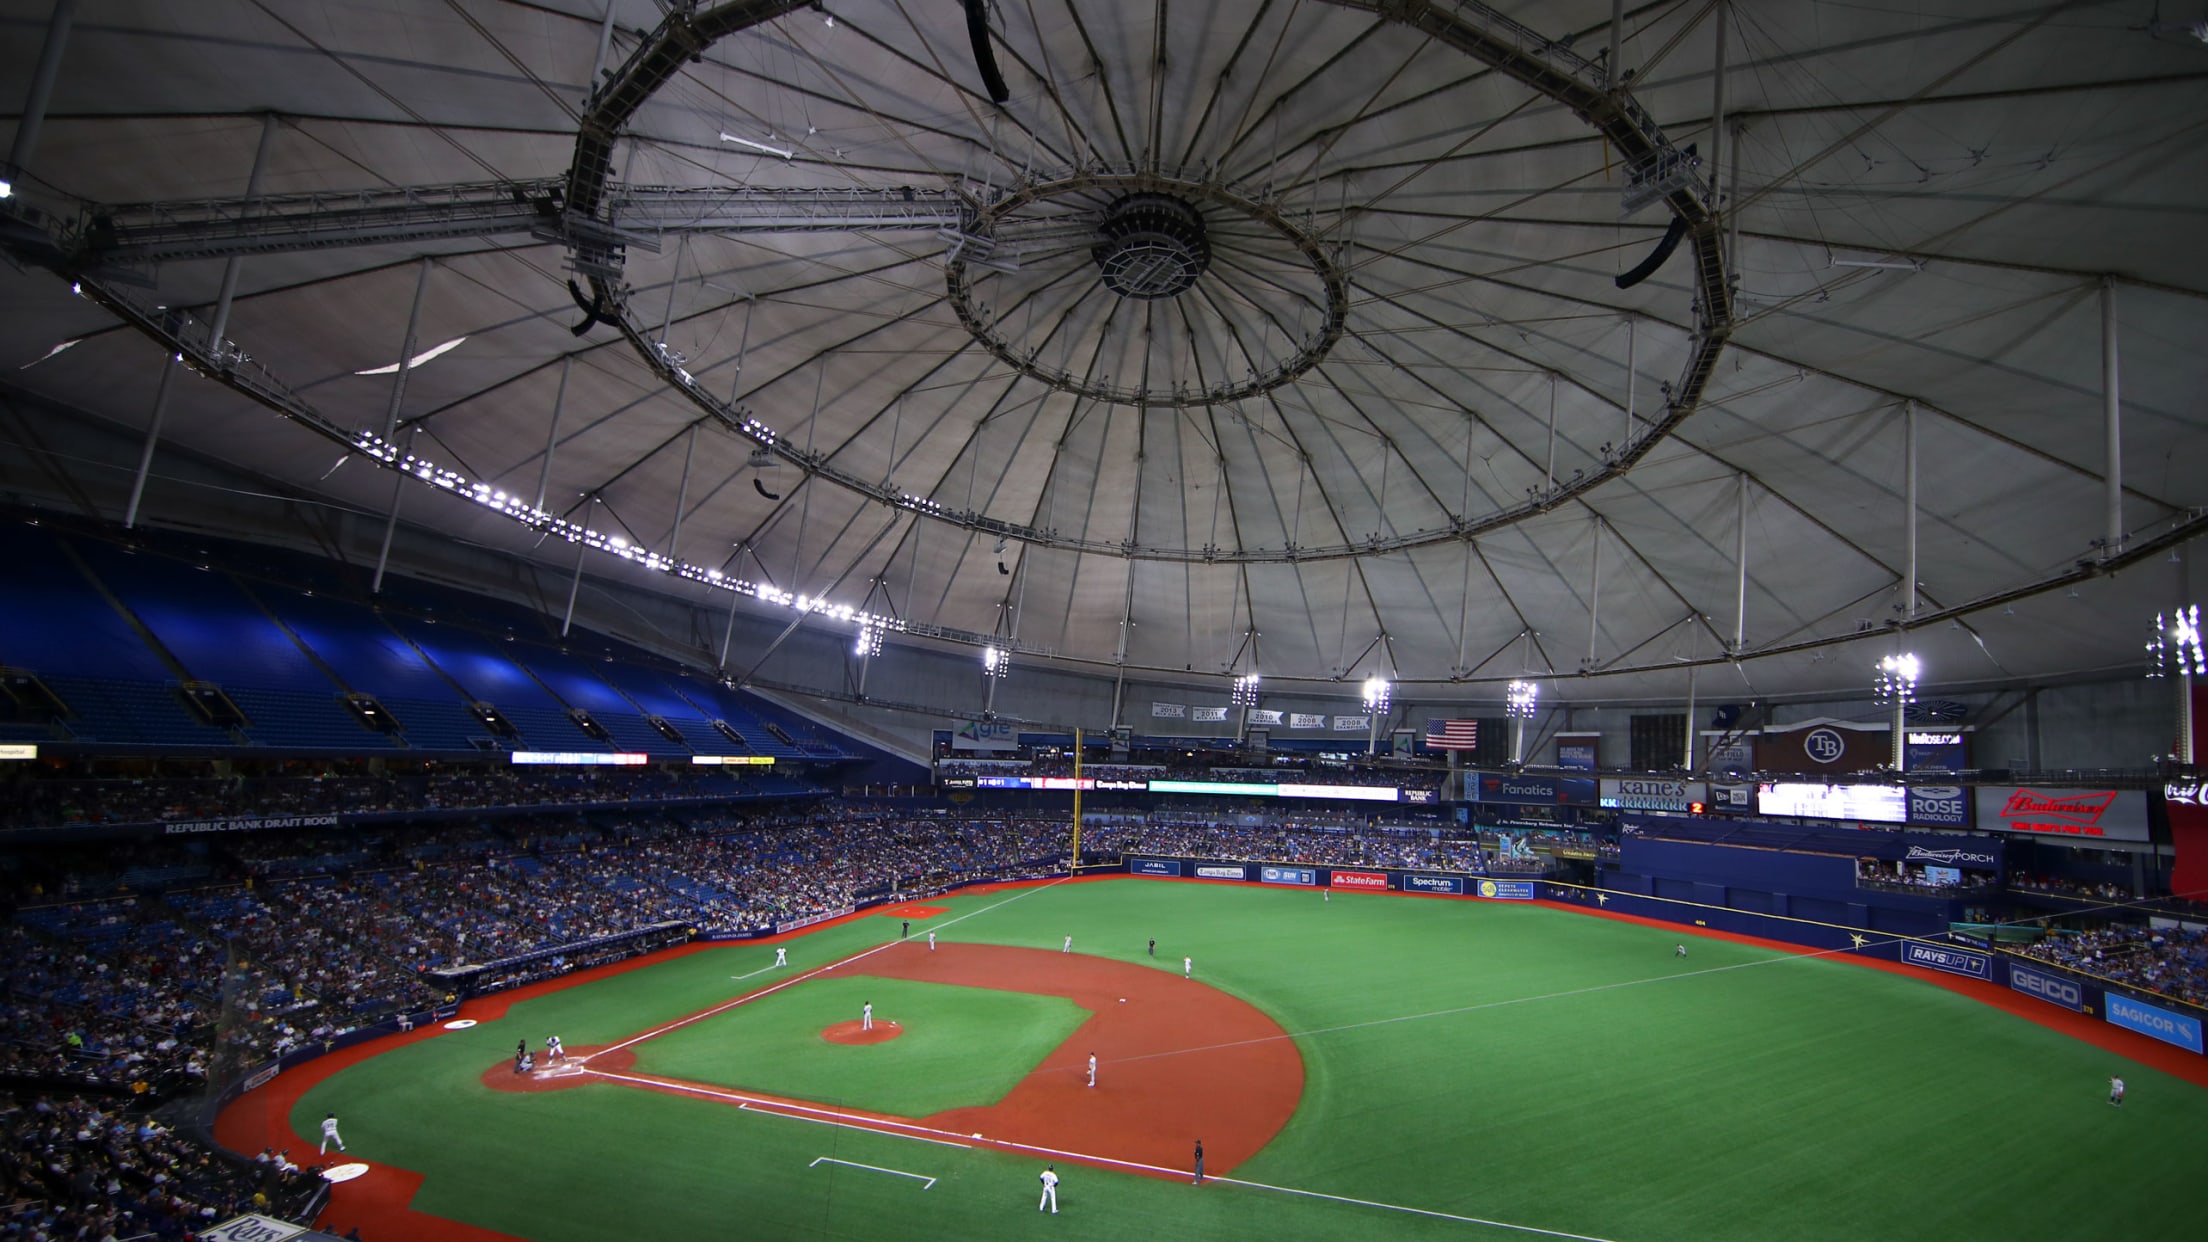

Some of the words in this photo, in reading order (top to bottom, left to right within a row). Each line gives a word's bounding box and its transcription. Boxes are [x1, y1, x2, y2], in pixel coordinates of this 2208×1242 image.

[1811, 735, 1838, 756] TB
[1502, 783, 1553, 796] Fanatics
[1691, 802, 1704, 814] 2
[1912, 799, 1963, 814] ROSE
[2010, 797, 2104, 814] Budweiser
[165, 821, 227, 834] REPUBLIC
[228, 819, 262, 831] BANK
[264, 817, 301, 828] DRAFT
[303, 815, 338, 827] ROOM
[1912, 813, 1962, 822] RADIOLOGY
[1910, 849, 1955, 859] Budweiser
[1955, 852, 1994, 863] PORCH
[1412, 878, 1451, 887] Spectrum
[2012, 970, 2078, 1004] GEICO
[2111, 1003, 2175, 1033] SAGICOR
